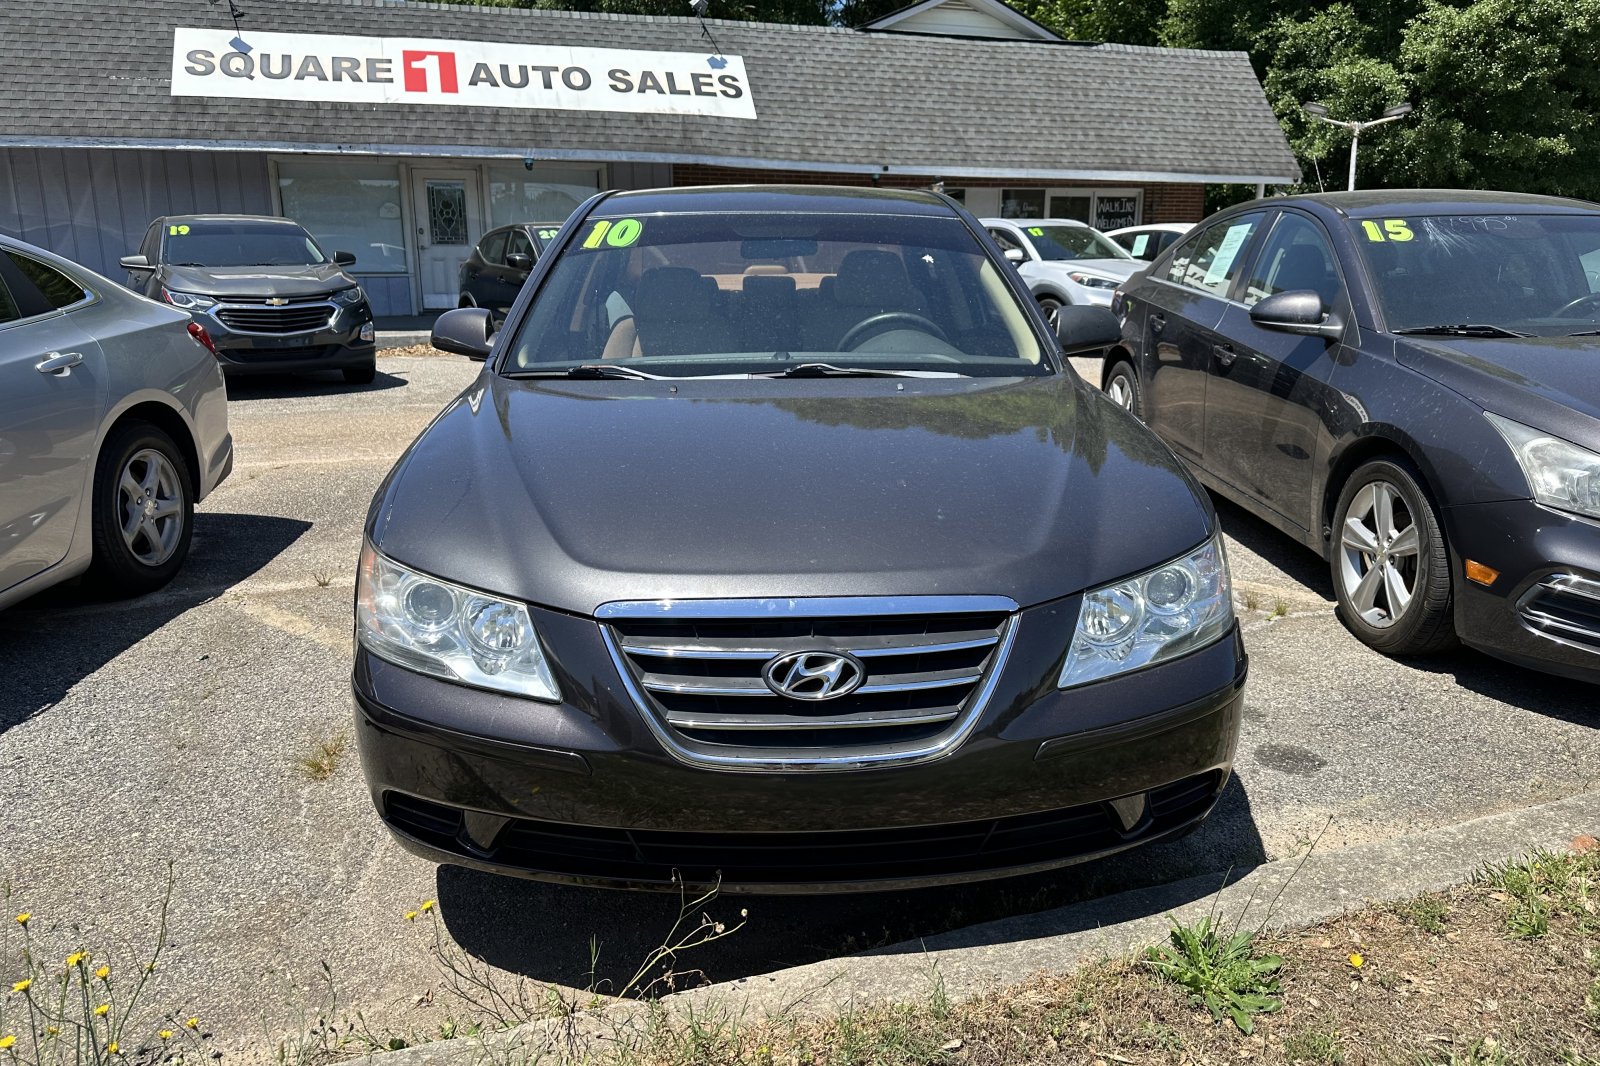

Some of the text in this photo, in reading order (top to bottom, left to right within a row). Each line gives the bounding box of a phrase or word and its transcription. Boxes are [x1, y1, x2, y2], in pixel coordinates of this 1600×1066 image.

[184, 49, 743, 99] SQUARE 1 AUTO SALES
[169, 224, 190, 236] 19
[582, 218, 643, 249] 10
[1027, 227, 1045, 237] 17
[1361, 219, 1415, 242] 15
